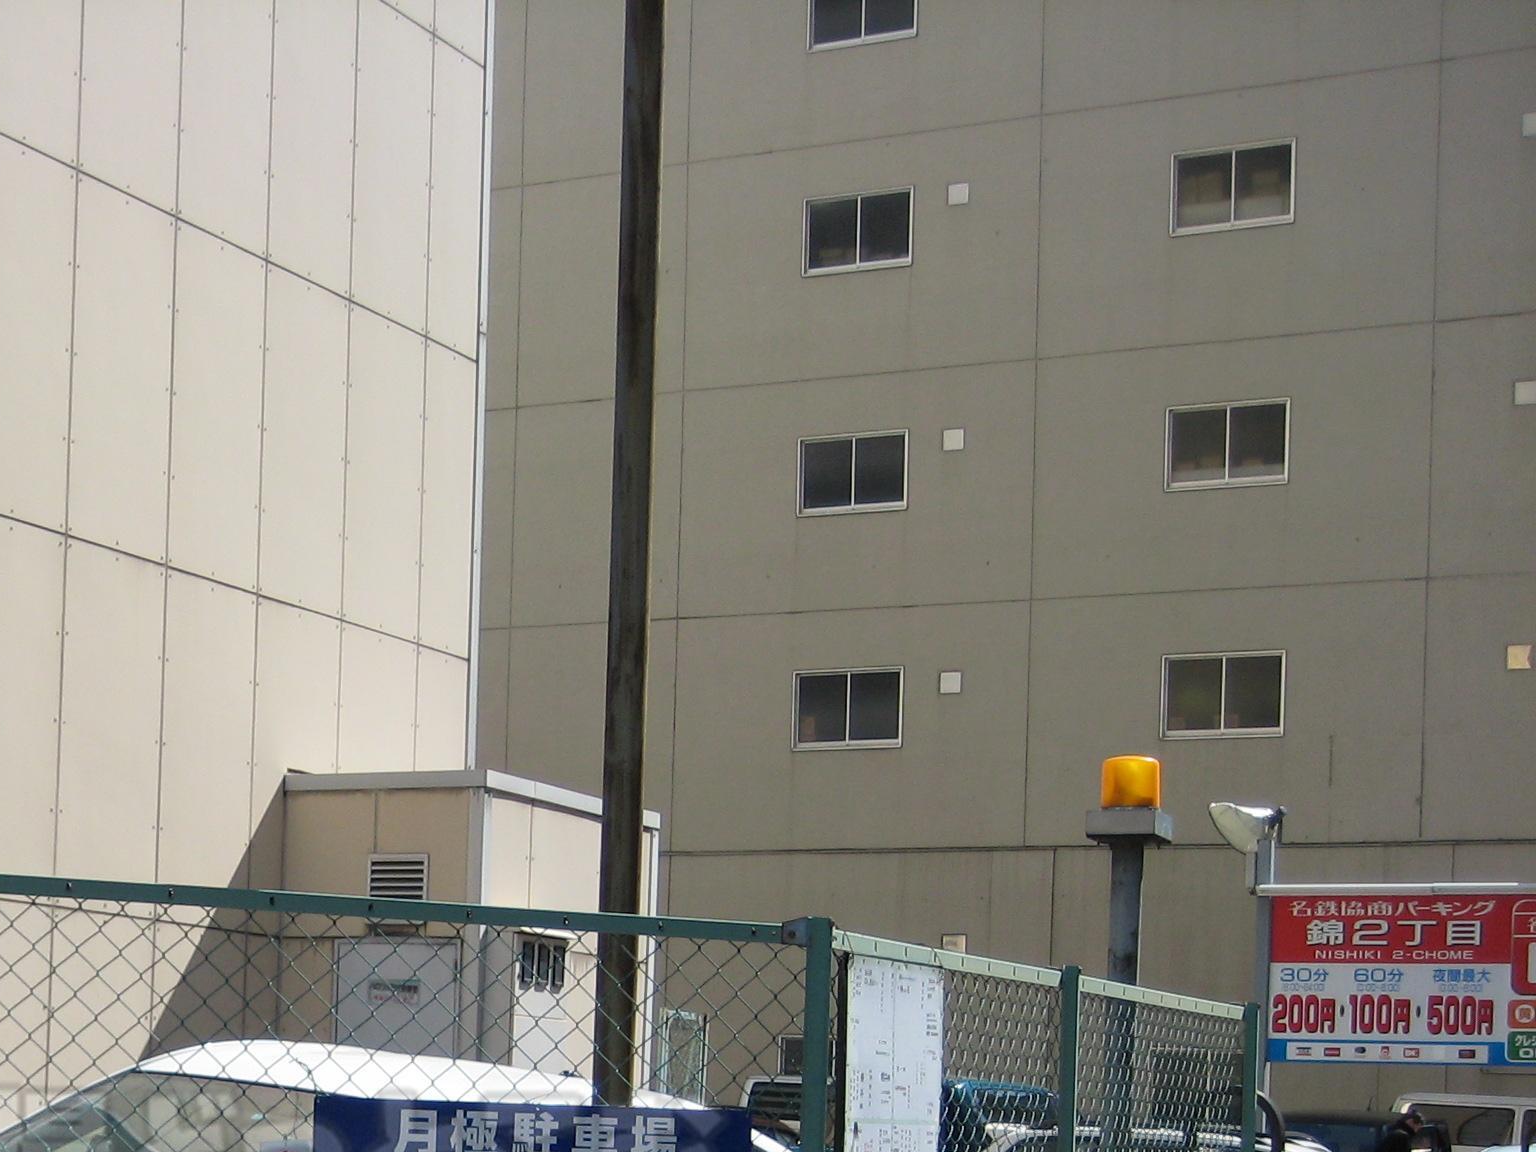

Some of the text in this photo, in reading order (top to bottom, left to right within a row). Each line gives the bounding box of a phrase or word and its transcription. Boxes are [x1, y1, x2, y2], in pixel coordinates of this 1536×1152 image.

[1288, 900, 1496, 917] 名鉄協商パーキング
[1306, 919, 1482, 947] 錦2丁目
[1315, 950, 1474, 961] NISHIKI 2-CHOME
[1280, 968, 1491, 984] 30分 60分 夜間最大
[1271, 994, 1336, 1034] 200円
[1349, 994, 1412, 1035] 100円
[1426, 995, 1494, 1036] 500円
